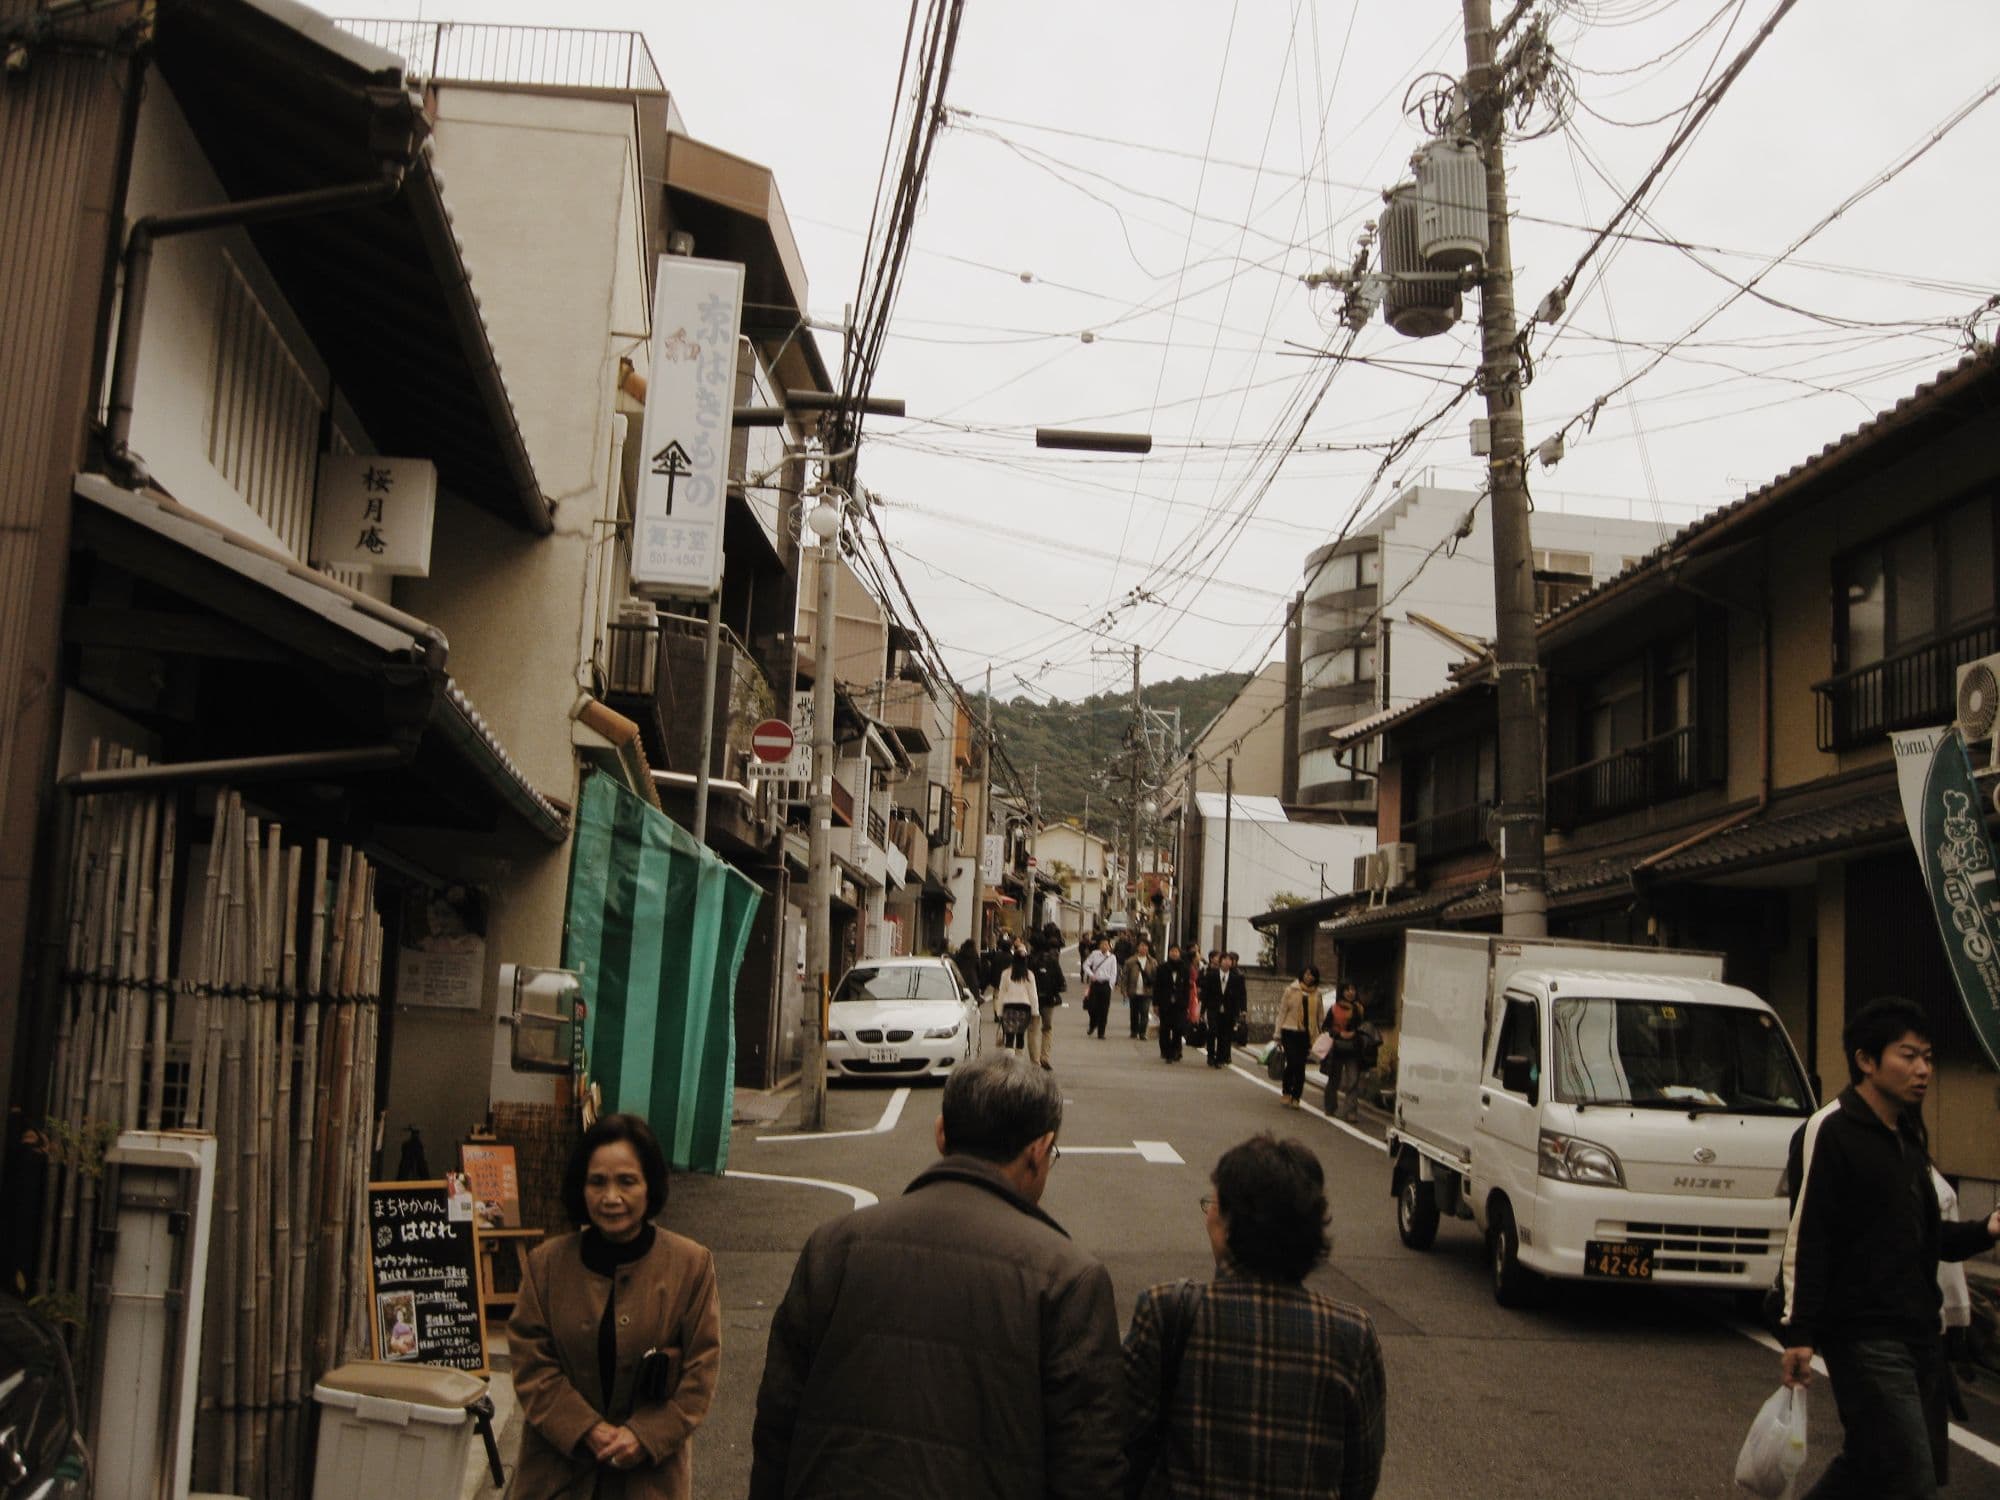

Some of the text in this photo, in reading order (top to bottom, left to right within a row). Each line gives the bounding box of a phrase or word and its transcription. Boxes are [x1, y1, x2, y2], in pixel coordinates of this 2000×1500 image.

[354, 463, 394, 554] 桜月庵
[1672, 1175, 1736, 1190] HIJET
[400, 1219, 458, 1242] はなれ
[1599, 1256, 1650, 1277] 42-66
